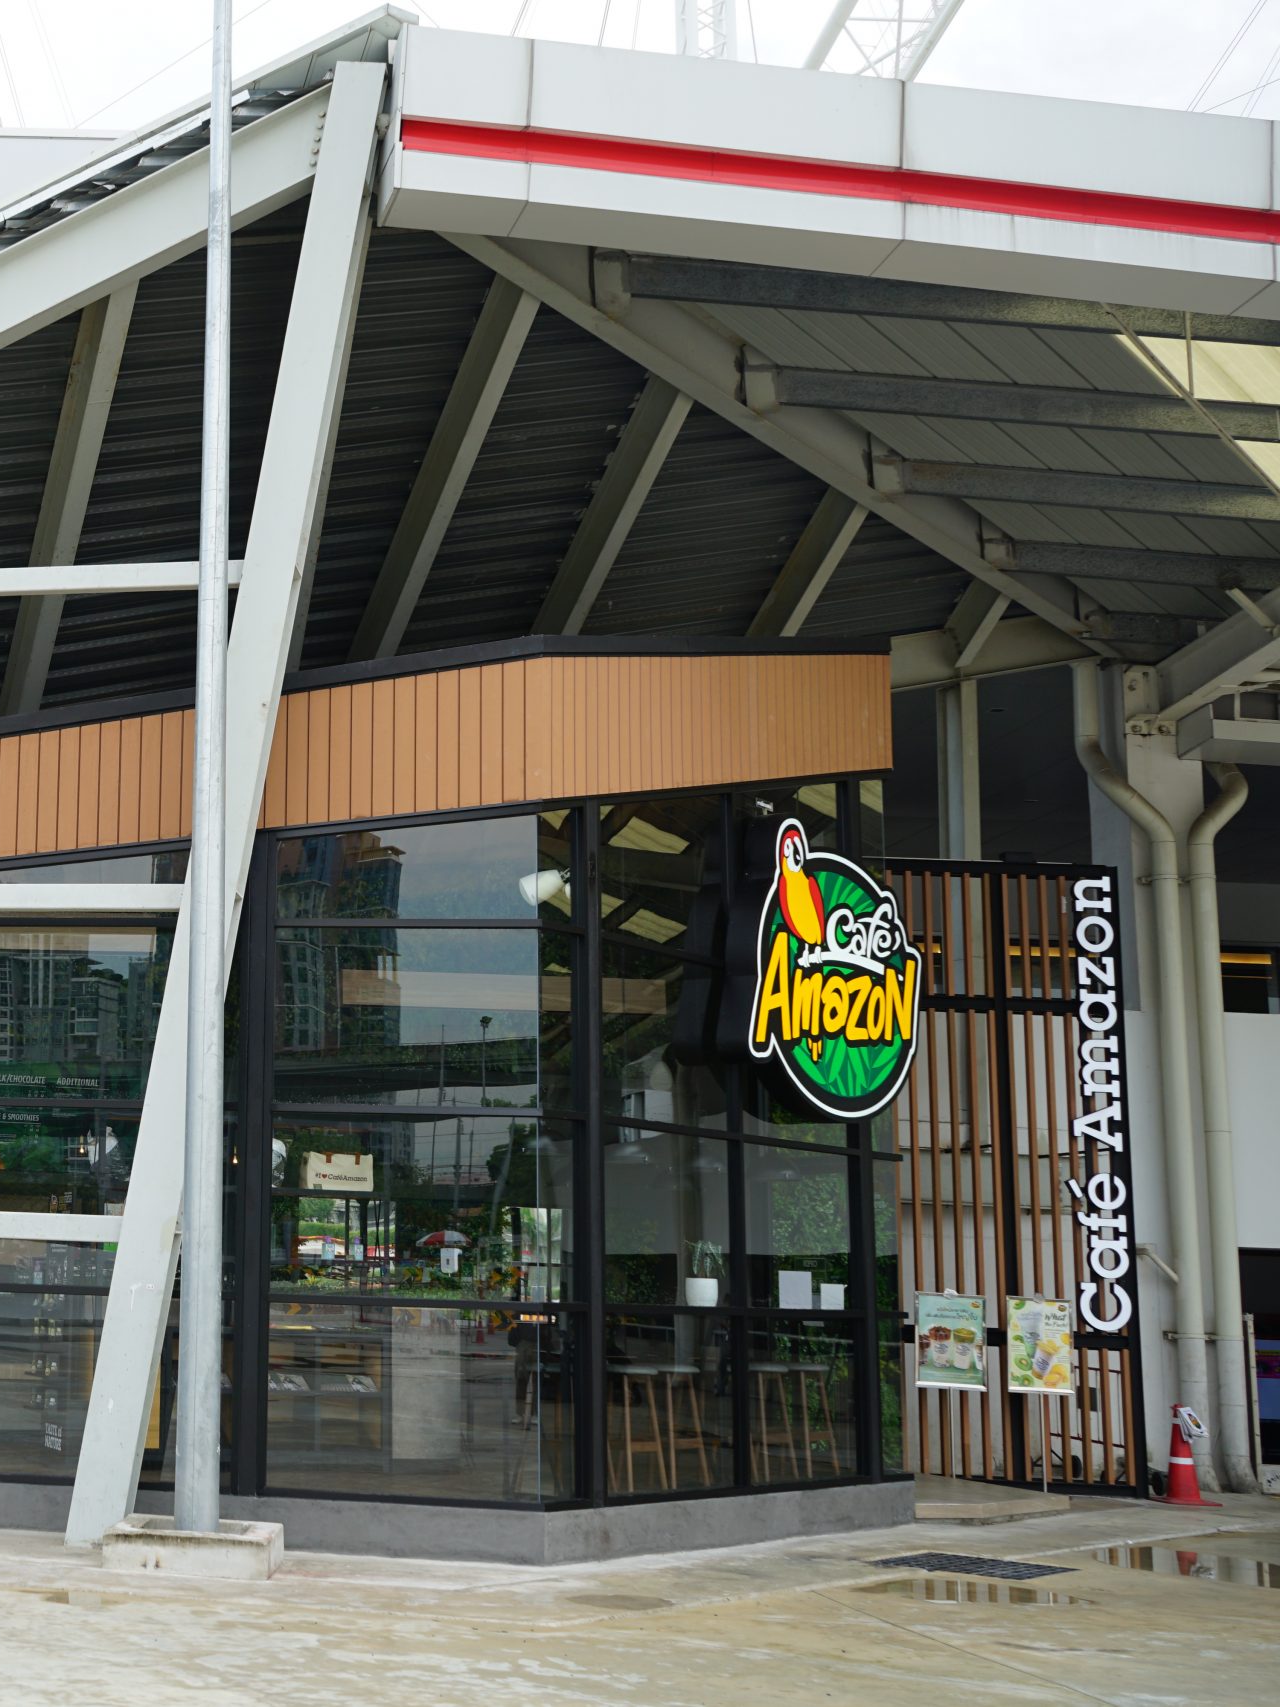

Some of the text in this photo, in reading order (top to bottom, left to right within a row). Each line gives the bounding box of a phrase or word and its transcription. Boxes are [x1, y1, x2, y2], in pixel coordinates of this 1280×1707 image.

[826, 903, 901, 959] Café
[56, 1077, 99, 1087] ADDITIONAL
[8, 1113, 40, 1121] SMOOTHIES
[1067, 876, 1132, 1333] Café Amazon
